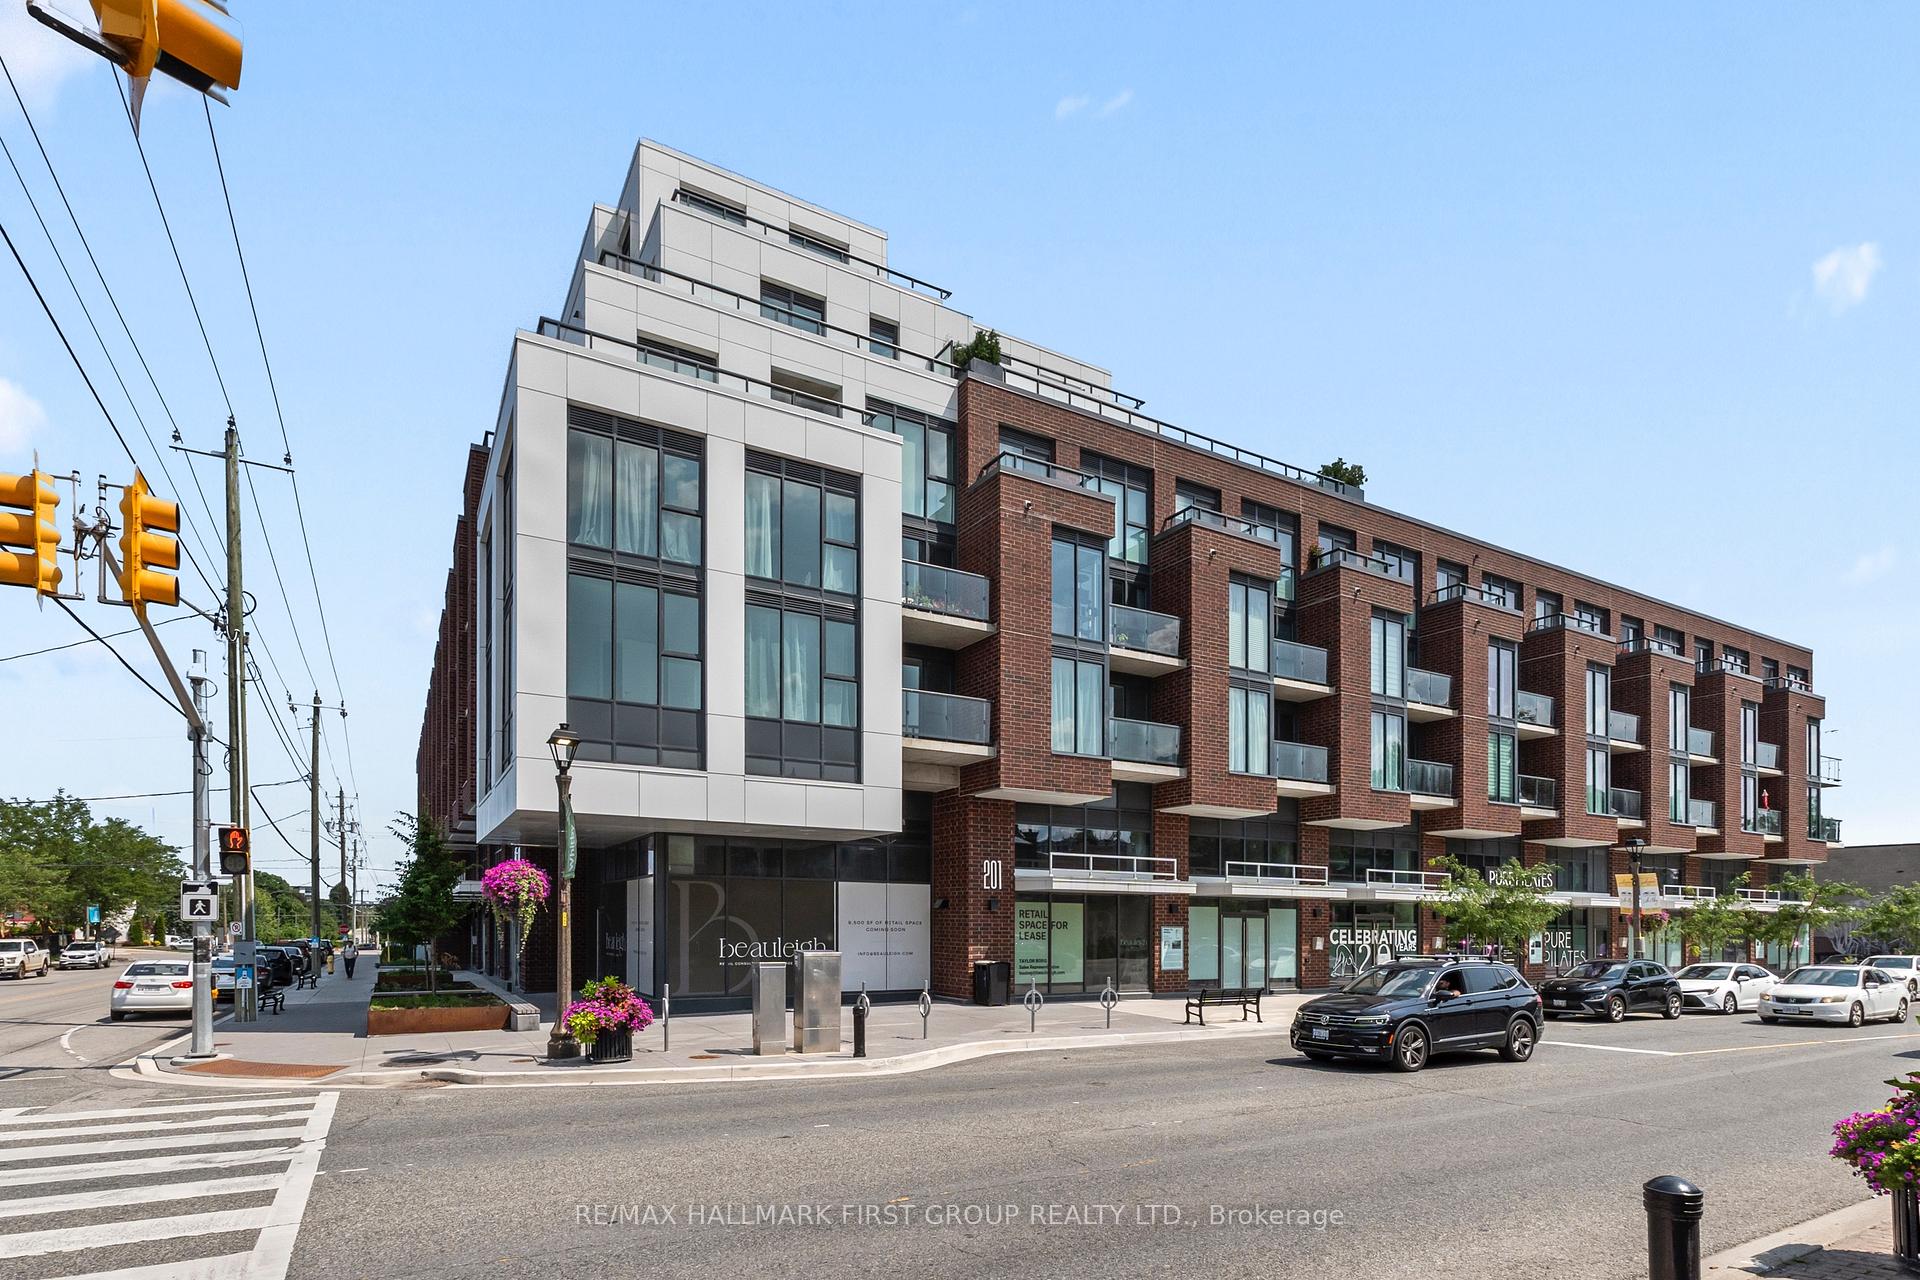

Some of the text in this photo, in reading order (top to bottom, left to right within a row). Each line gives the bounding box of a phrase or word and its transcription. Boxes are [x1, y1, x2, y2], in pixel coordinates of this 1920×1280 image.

[983, 860, 1002, 890] 201
[1019, 910, 1048, 919] RETAIL
[1019, 921, 1068, 930] SPACE FOR
[1019, 931, 1046, 941] LEASE
[1329, 928, 1417, 945] CELEBRATING
[1544, 931, 1571, 949] PURE
[1395, 943, 1417, 952] YEARS
